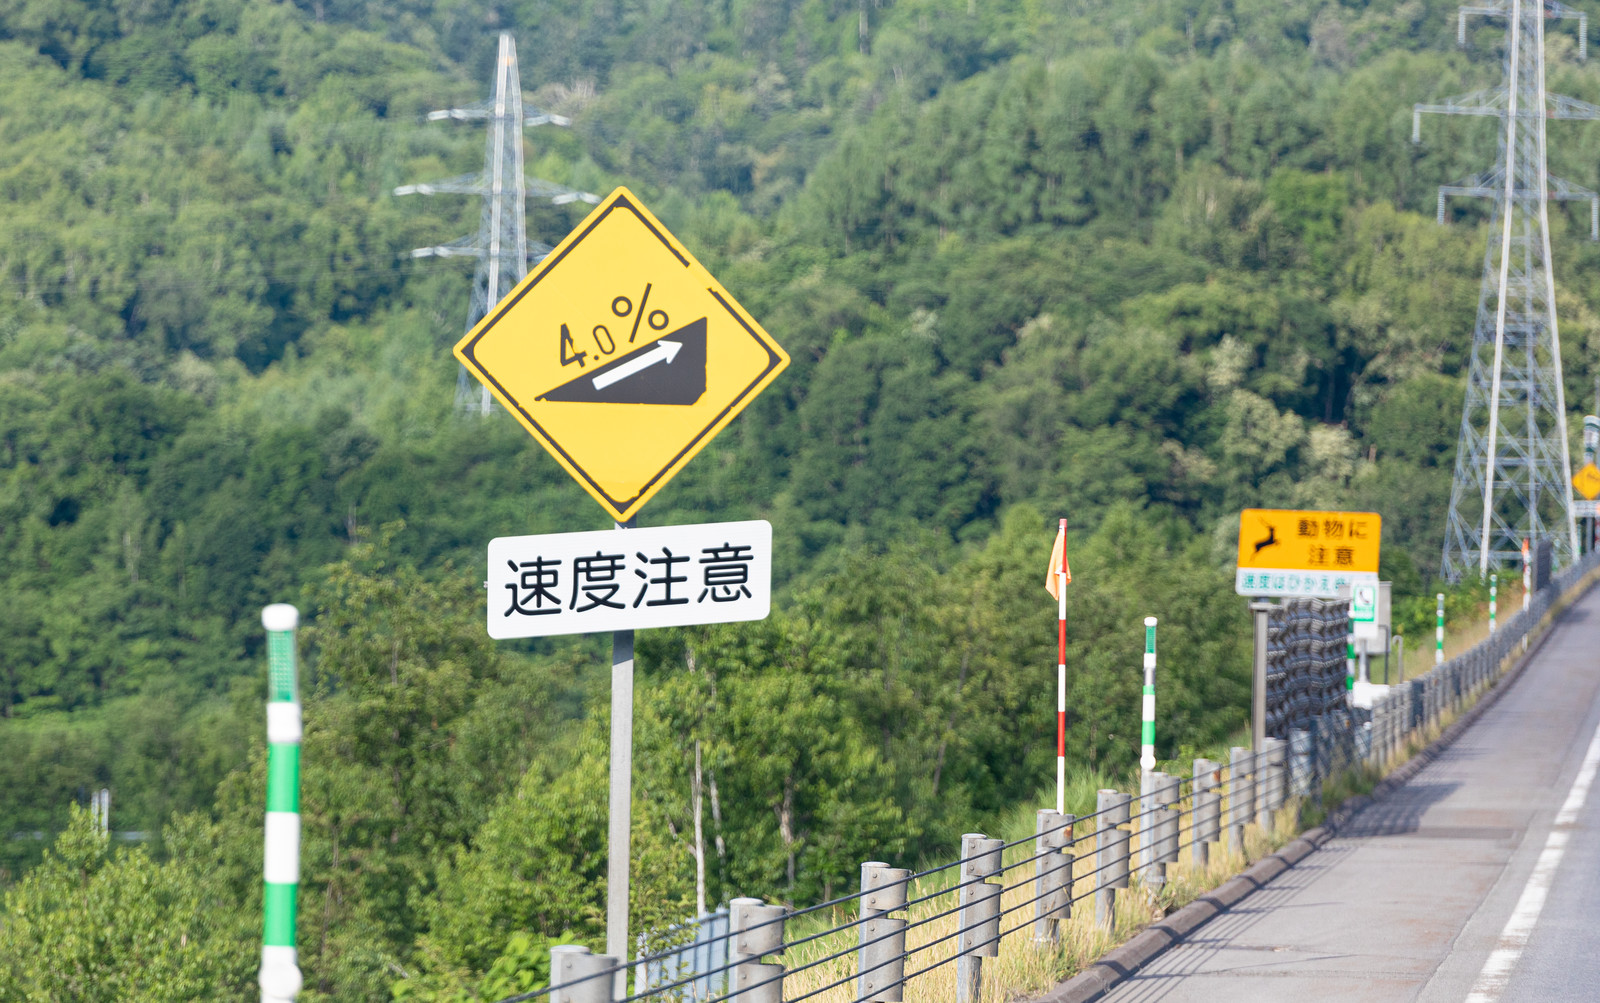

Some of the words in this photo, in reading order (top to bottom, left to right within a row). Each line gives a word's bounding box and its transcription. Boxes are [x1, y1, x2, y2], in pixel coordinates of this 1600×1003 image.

[560, 283, 669, 368] 4.0%
[1298, 517, 1368, 539] 動物に
[1308, 545, 1355, 566] 注意
[504, 543, 755, 617] 速度注意
